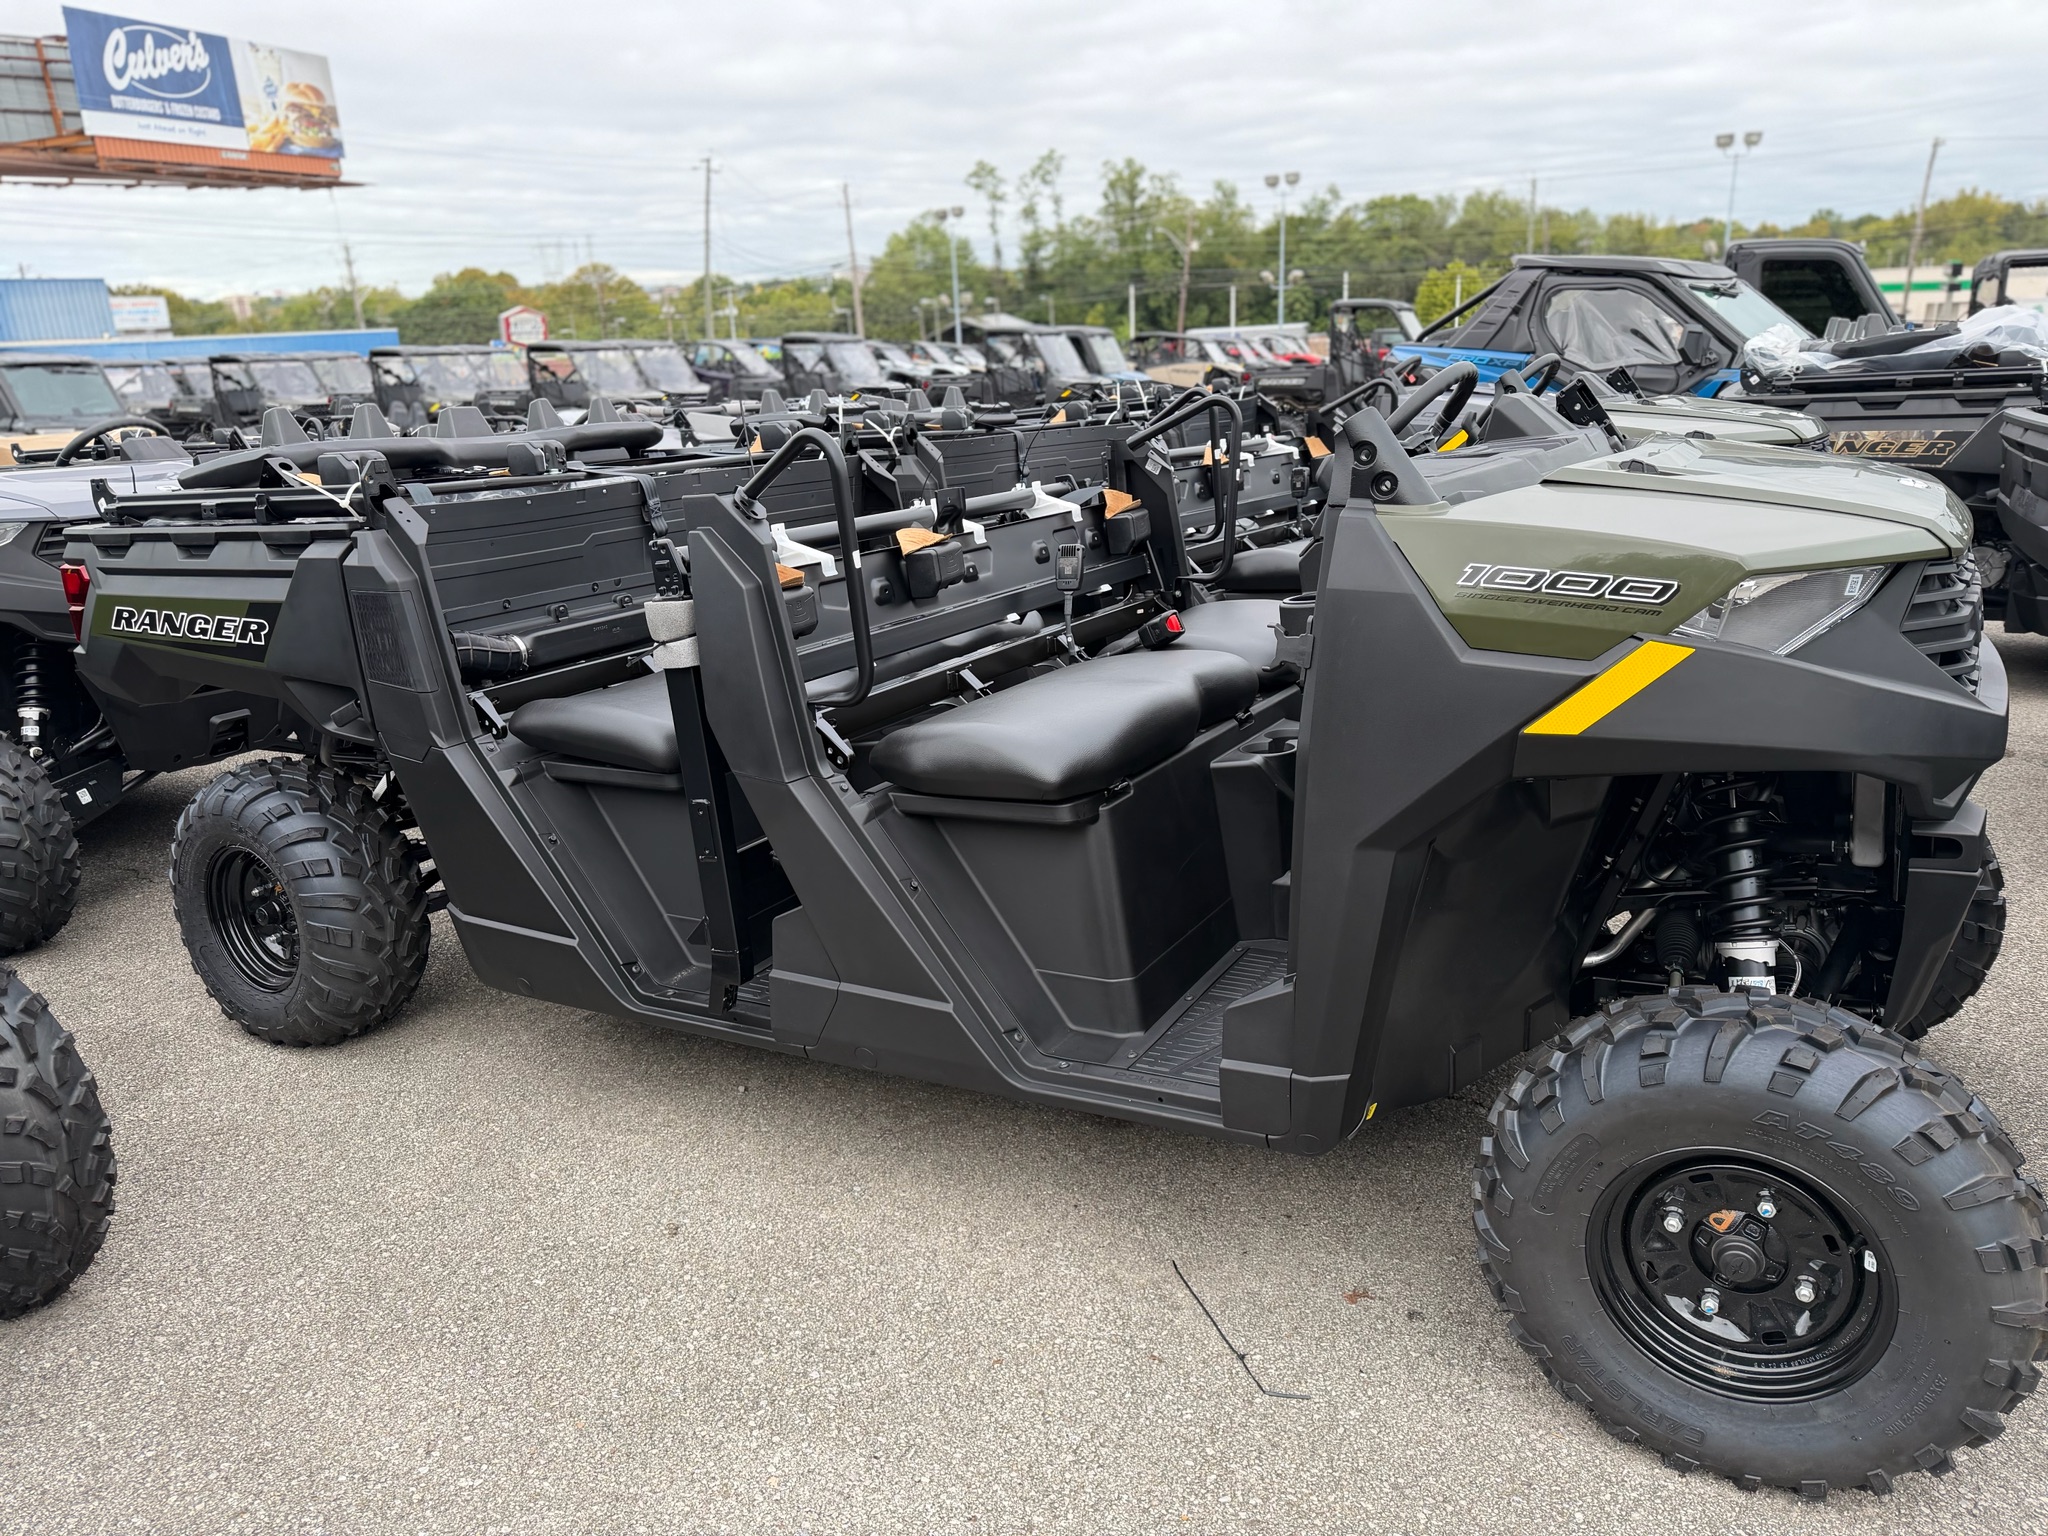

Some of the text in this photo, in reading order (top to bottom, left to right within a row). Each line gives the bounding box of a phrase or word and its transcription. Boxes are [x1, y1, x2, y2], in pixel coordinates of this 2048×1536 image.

[103, 27, 210, 91] Culver's
[1454, 590, 1664, 617] SINGLE OVERHEAD CAM
[1456, 563, 1680, 604] 1000
[111, 606, 269, 645] RANGER
[1752, 1109, 1921, 1211] AT489
[1561, 1333, 1707, 1447] CARLSTAR
